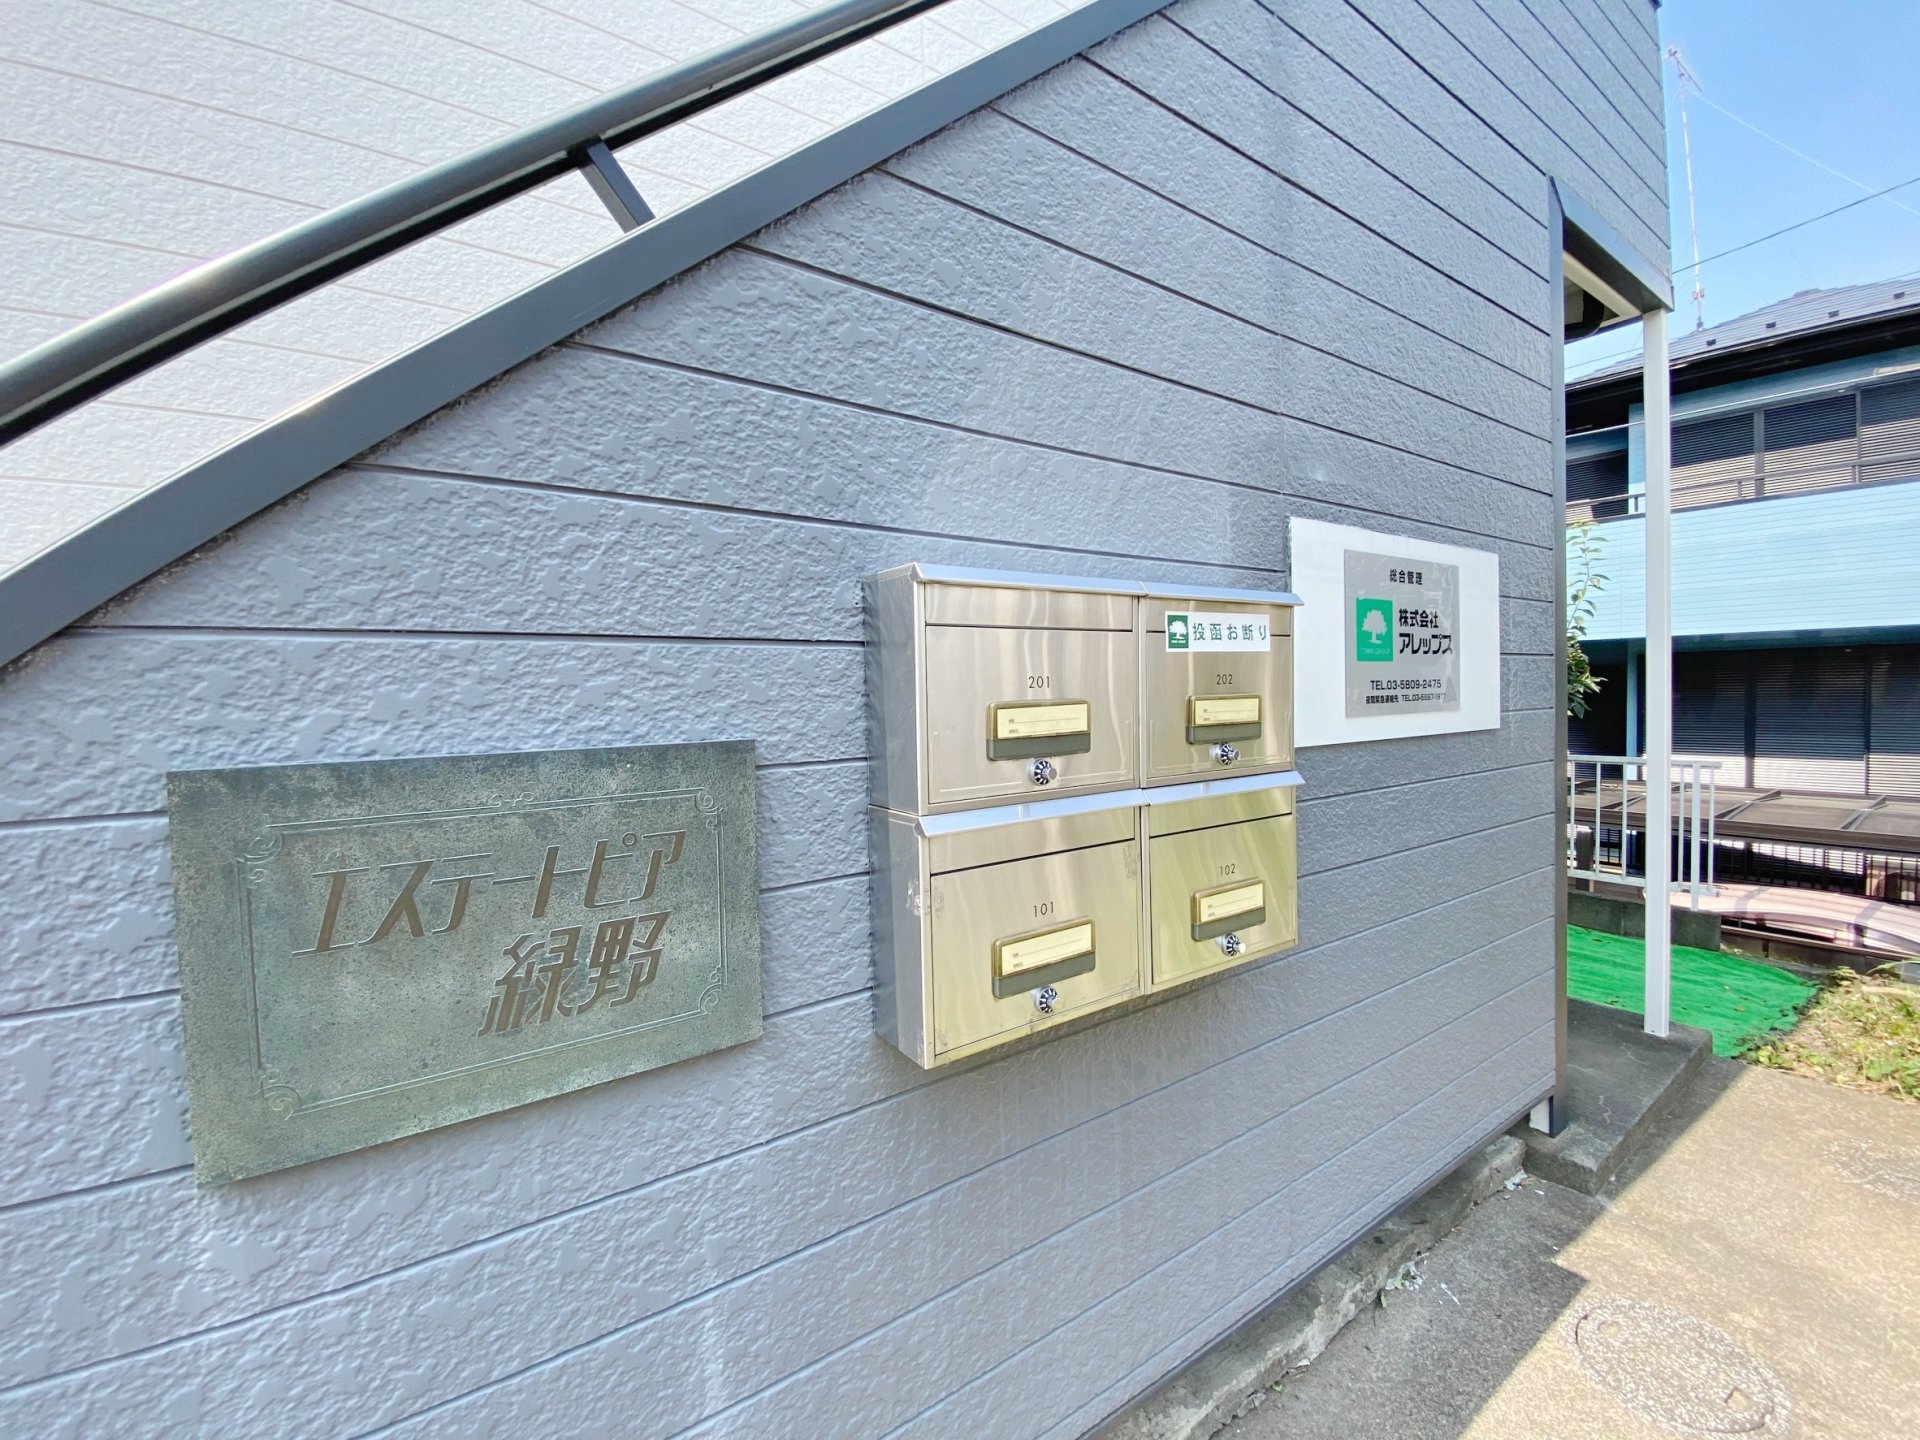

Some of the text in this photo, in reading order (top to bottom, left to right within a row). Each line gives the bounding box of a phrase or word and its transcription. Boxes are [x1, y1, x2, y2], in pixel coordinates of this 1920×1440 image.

[1389, 569, 1423, 586] 総合管理
[1399, 608, 1439, 629] 株式会社
[1192, 622, 1267, 641] 投函お断り
[1399, 633, 1453, 655] アレップス
[1028, 675, 1051, 689] 201
[1215, 673, 1233, 685] 202
[1218, 863, 1236, 877] 102
[292, 829, 687, 958] エステートピア
[1033, 902, 1055, 917] 101
